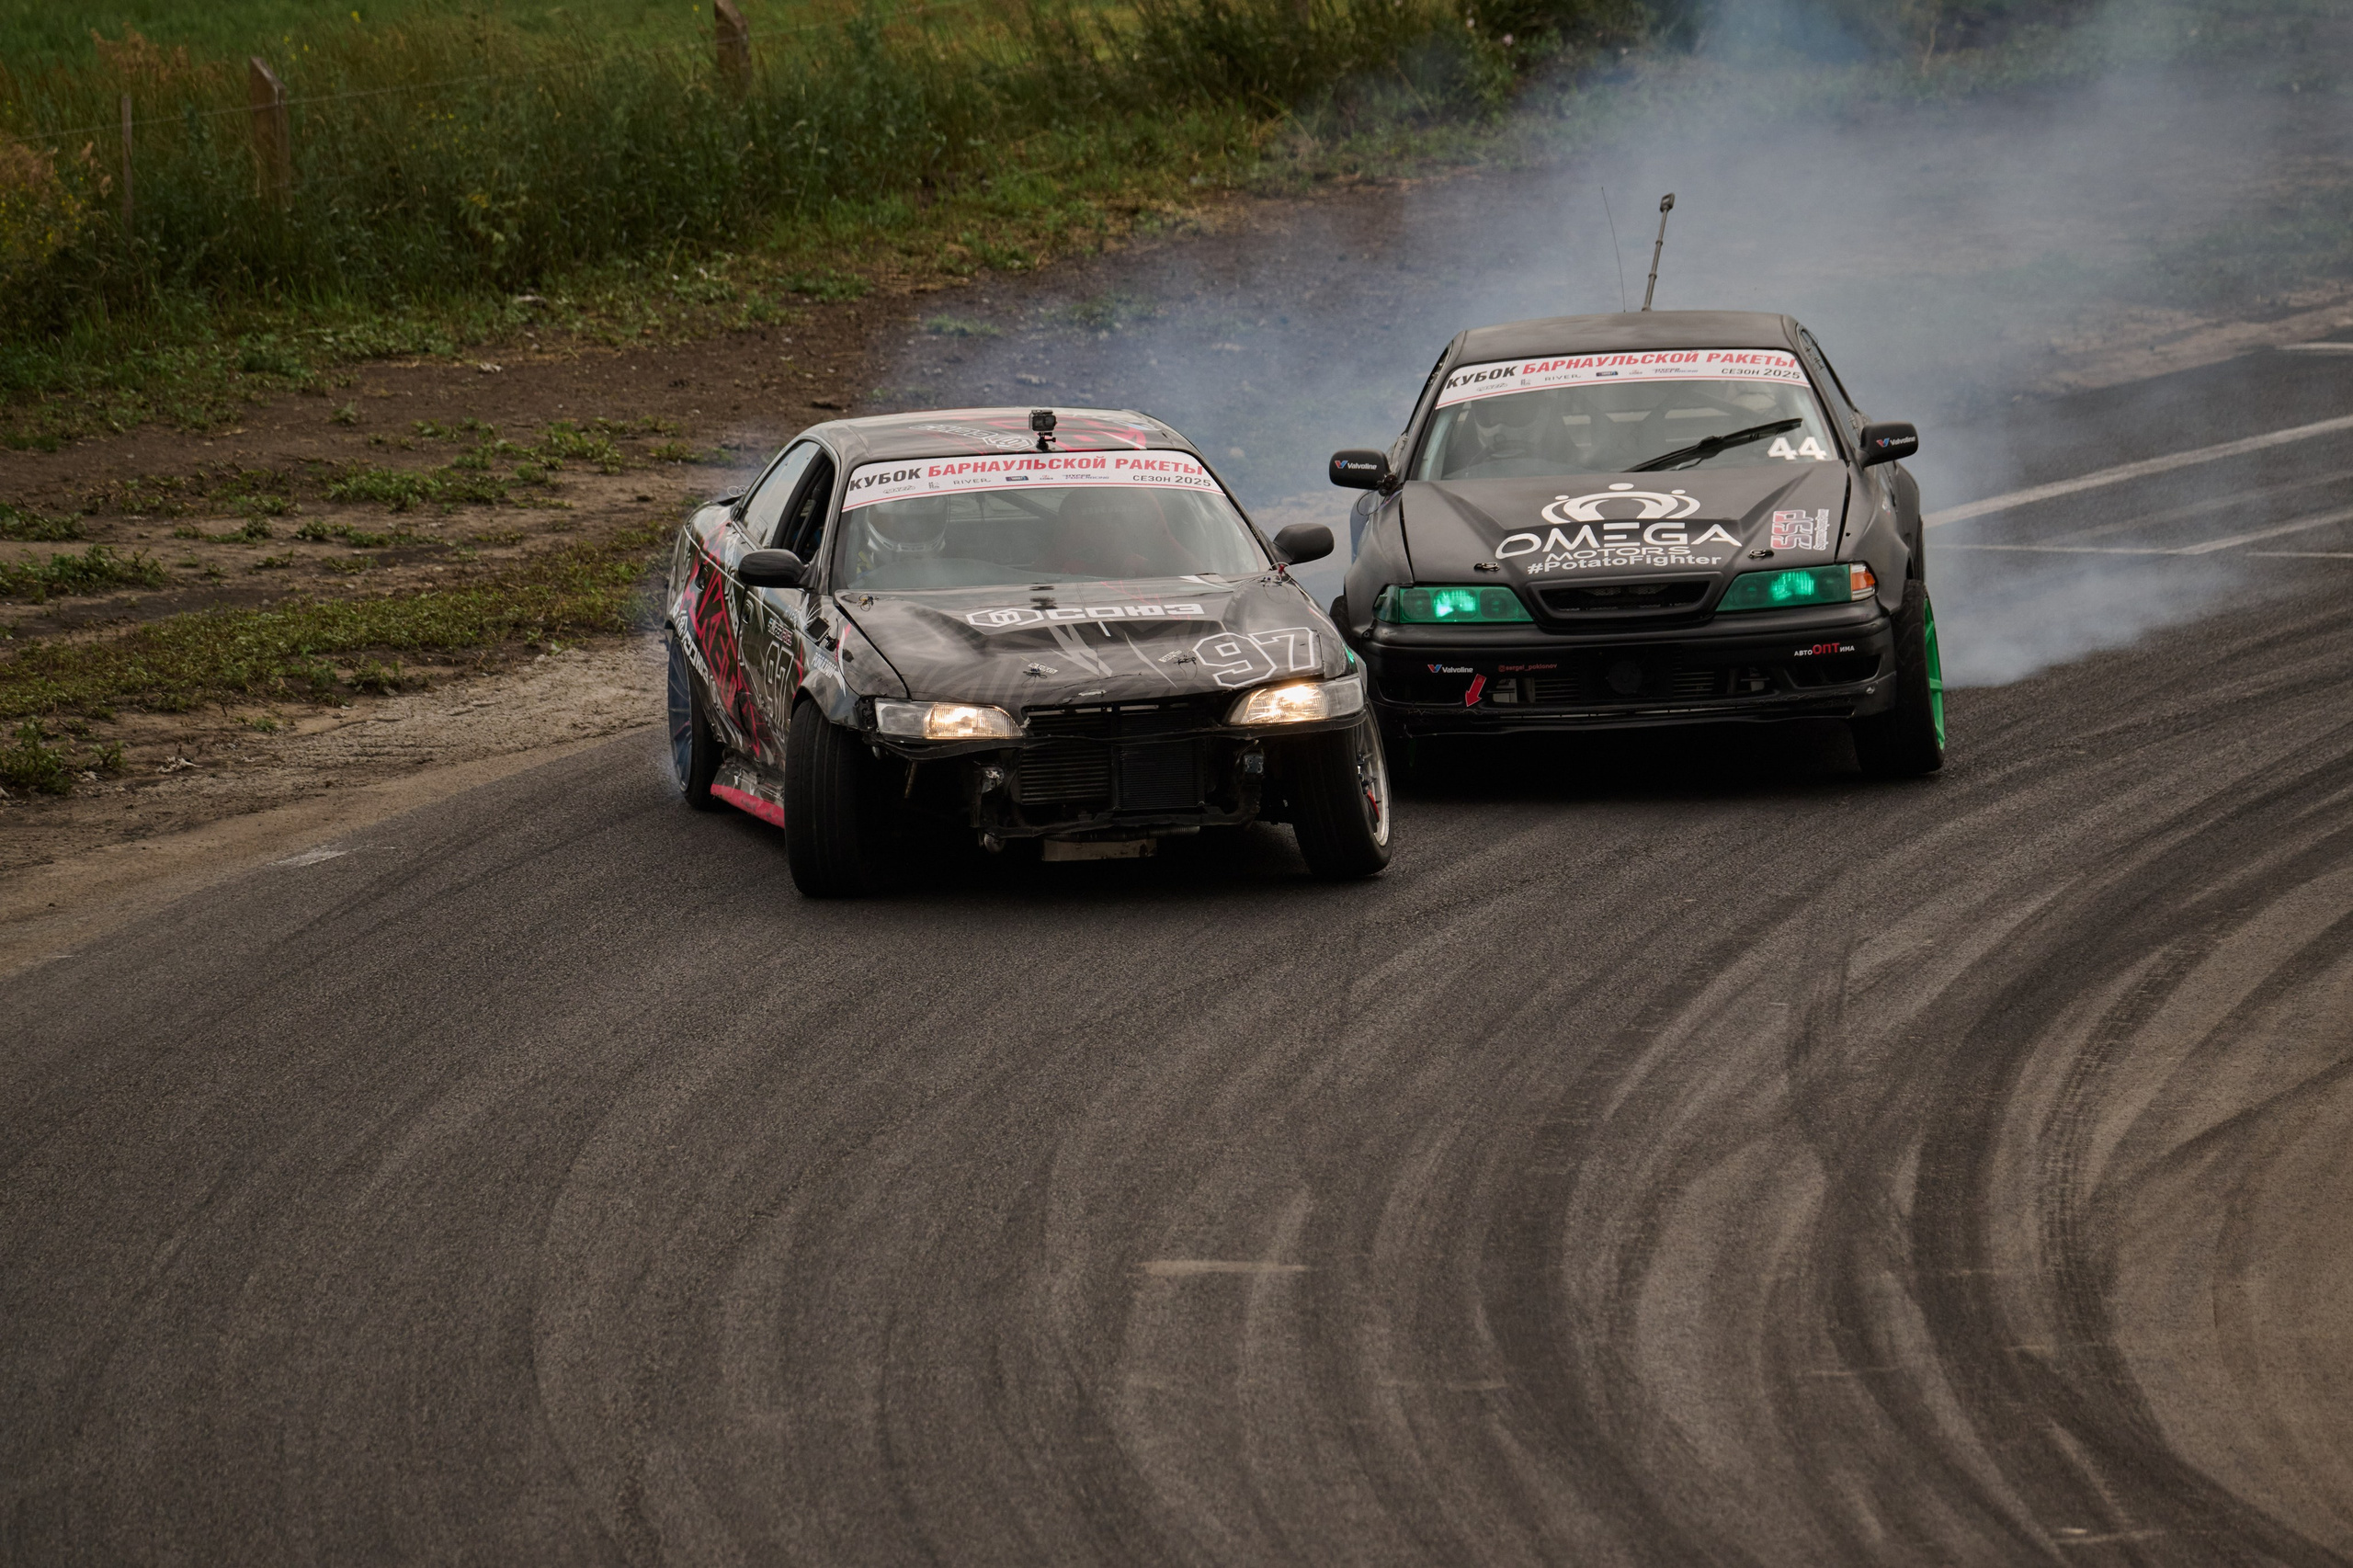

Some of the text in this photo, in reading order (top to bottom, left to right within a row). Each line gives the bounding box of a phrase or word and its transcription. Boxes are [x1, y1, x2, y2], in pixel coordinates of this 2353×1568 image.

[1446, 366, 1518, 390] КУБОК
[1522, 350, 1699, 375] БАРНАУЛЬСКОЙ
[1706, 353, 1797, 369] РАКЕТЫ
[1722, 368, 1801, 380] СЕЗОН 2025
[1767, 436, 1827, 461] 44
[1890, 436, 1916, 446] Valvoline
[848, 467, 922, 492] КУБОК
[927, 456, 1107, 478] БАРНАУЛЬСКОЙ
[1115, 458, 1203, 475] РАКЕТЫ
[1347, 462, 1378, 471] Valvoline
[1132, 474, 1211, 487] СЕЗОН 2025
[1770, 509, 1814, 550] SSP
[1495, 521, 1743, 560] OMEGA
[1545, 546, 1691, 562] MOTORS
[1527, 553, 1722, 575] #PotatoFighter
[1049, 603, 1205, 620] СОЮЗ
[1193, 626, 1318, 688] 97
[1441, 665, 1474, 674] Valvoline
